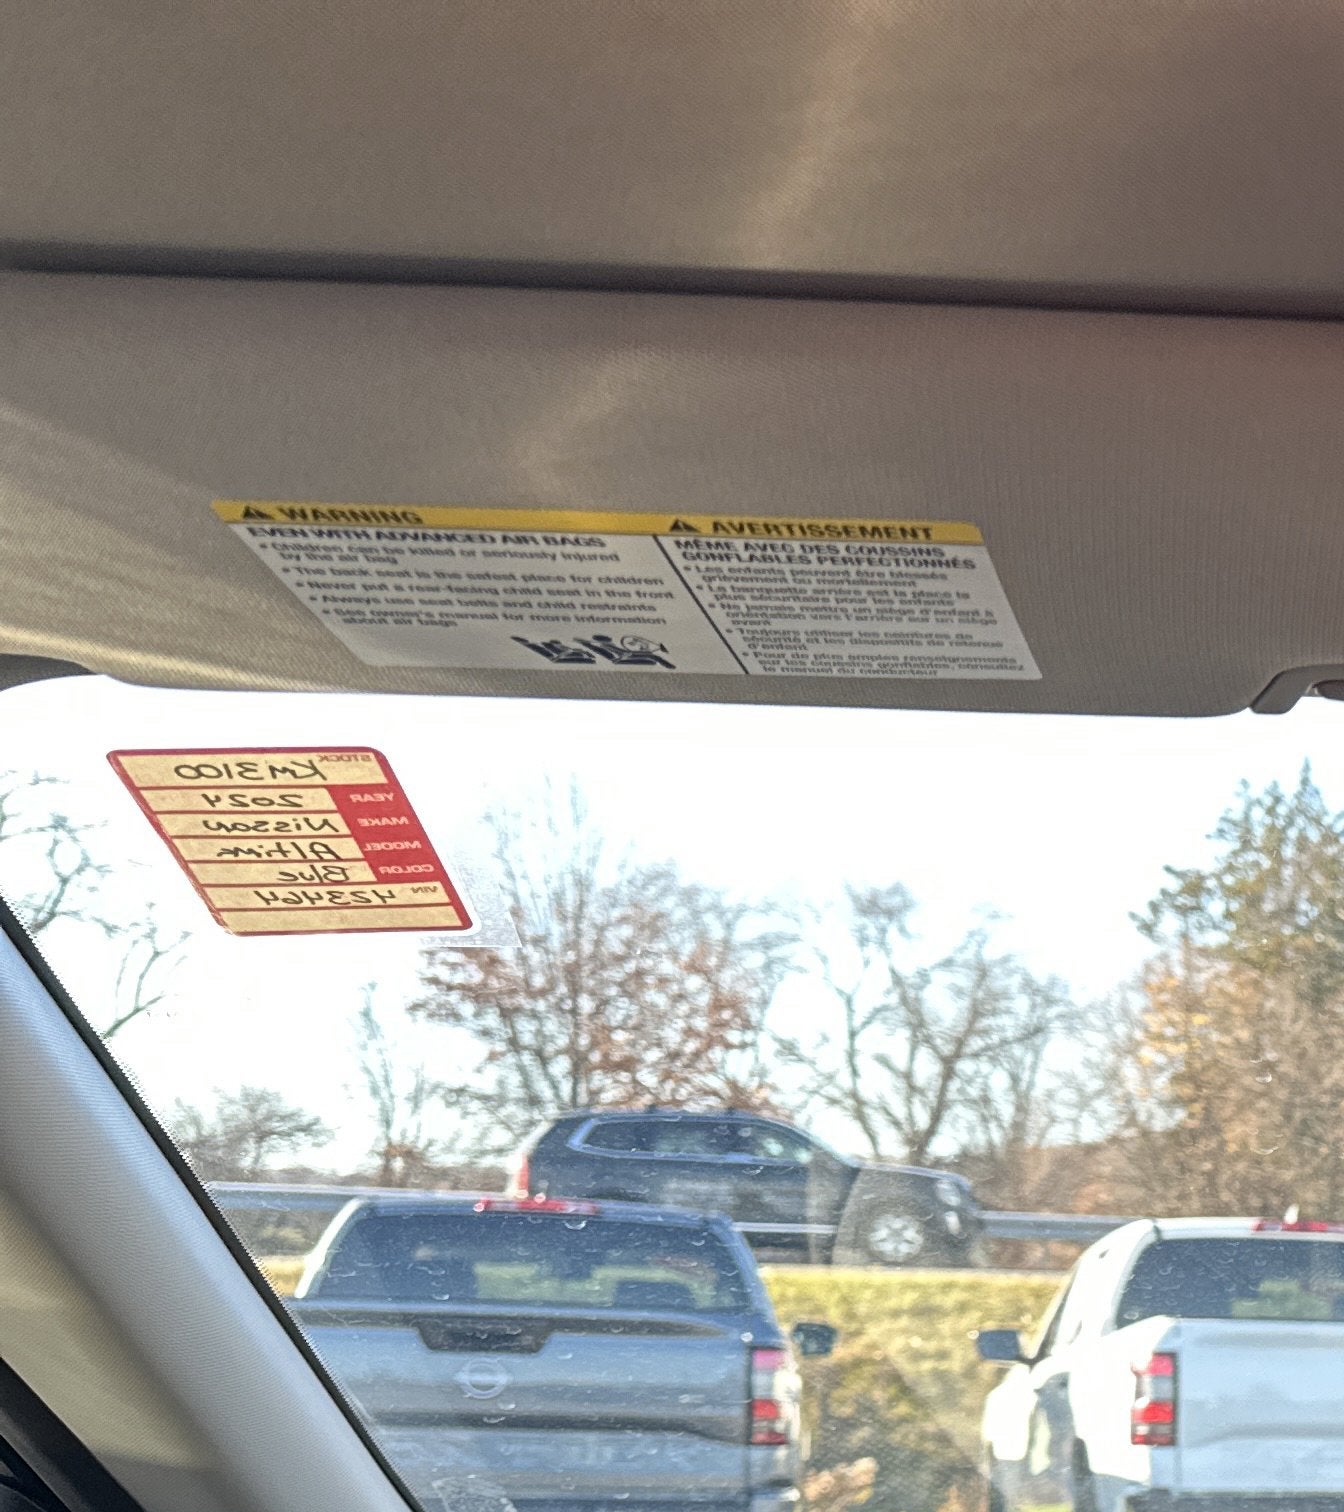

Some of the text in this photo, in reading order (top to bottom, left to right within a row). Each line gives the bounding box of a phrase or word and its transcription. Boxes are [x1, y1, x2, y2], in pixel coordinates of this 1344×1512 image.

[277, 507, 423, 524] WARNING
[247, 527, 309, 538] EVEN
[375, 530, 496, 545] ADVANCED
[502, 535, 540, 545] AIR
[712, 520, 933, 540] AVERTISSEMENT
